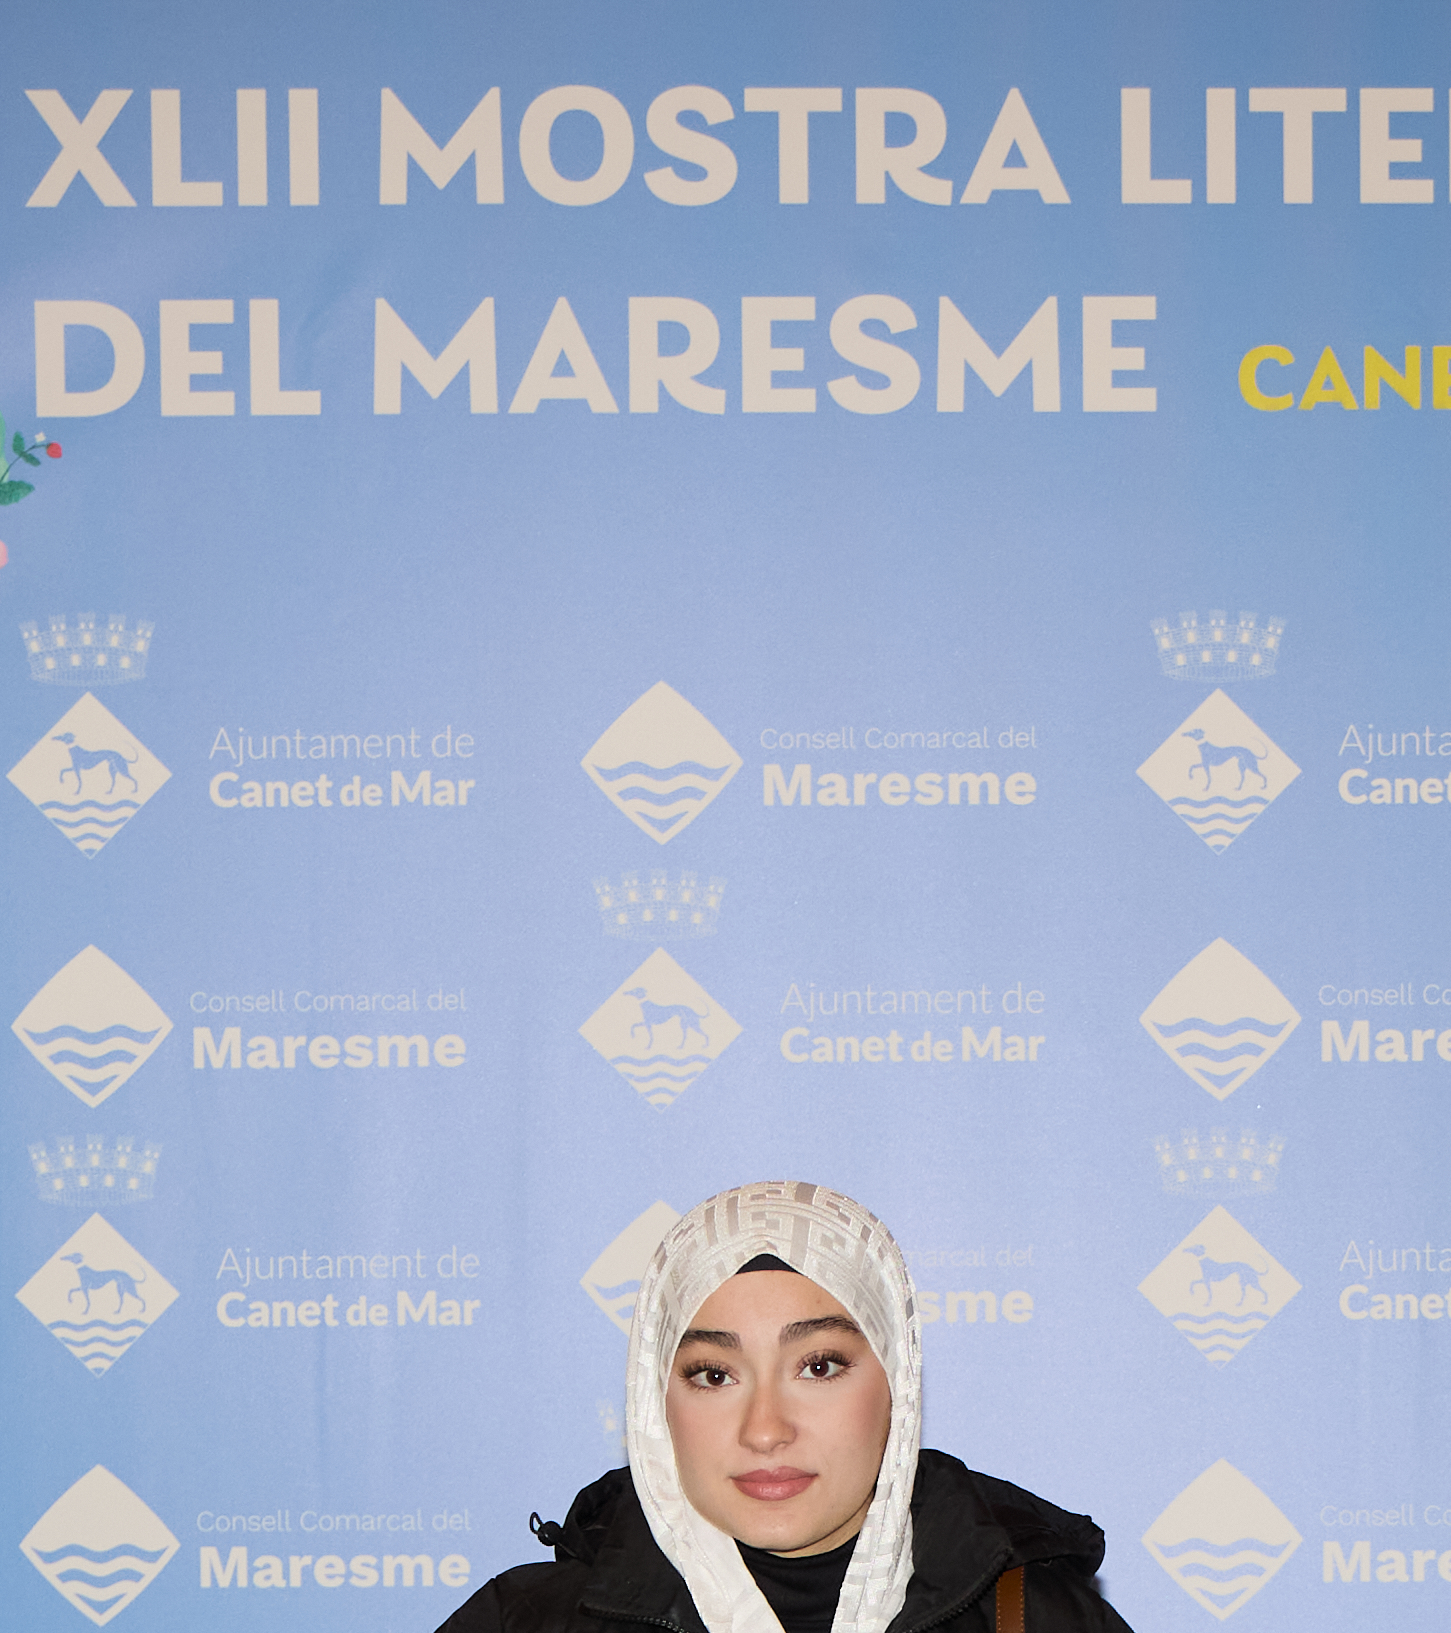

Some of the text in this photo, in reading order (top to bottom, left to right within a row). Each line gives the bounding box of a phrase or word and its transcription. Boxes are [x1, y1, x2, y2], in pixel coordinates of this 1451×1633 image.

[25, 88, 320, 207] XLII
[380, 85, 1070, 206] MOSTRA
[34, 294, 1157, 417] DEL MARESME
[210, 726, 473, 766] Ajuntament de
[209, 770, 475, 808] Canet de Mar
[781, 982, 1044, 1021] Ajuntament de
[780, 1026, 1046, 1063] Canet de Mar
